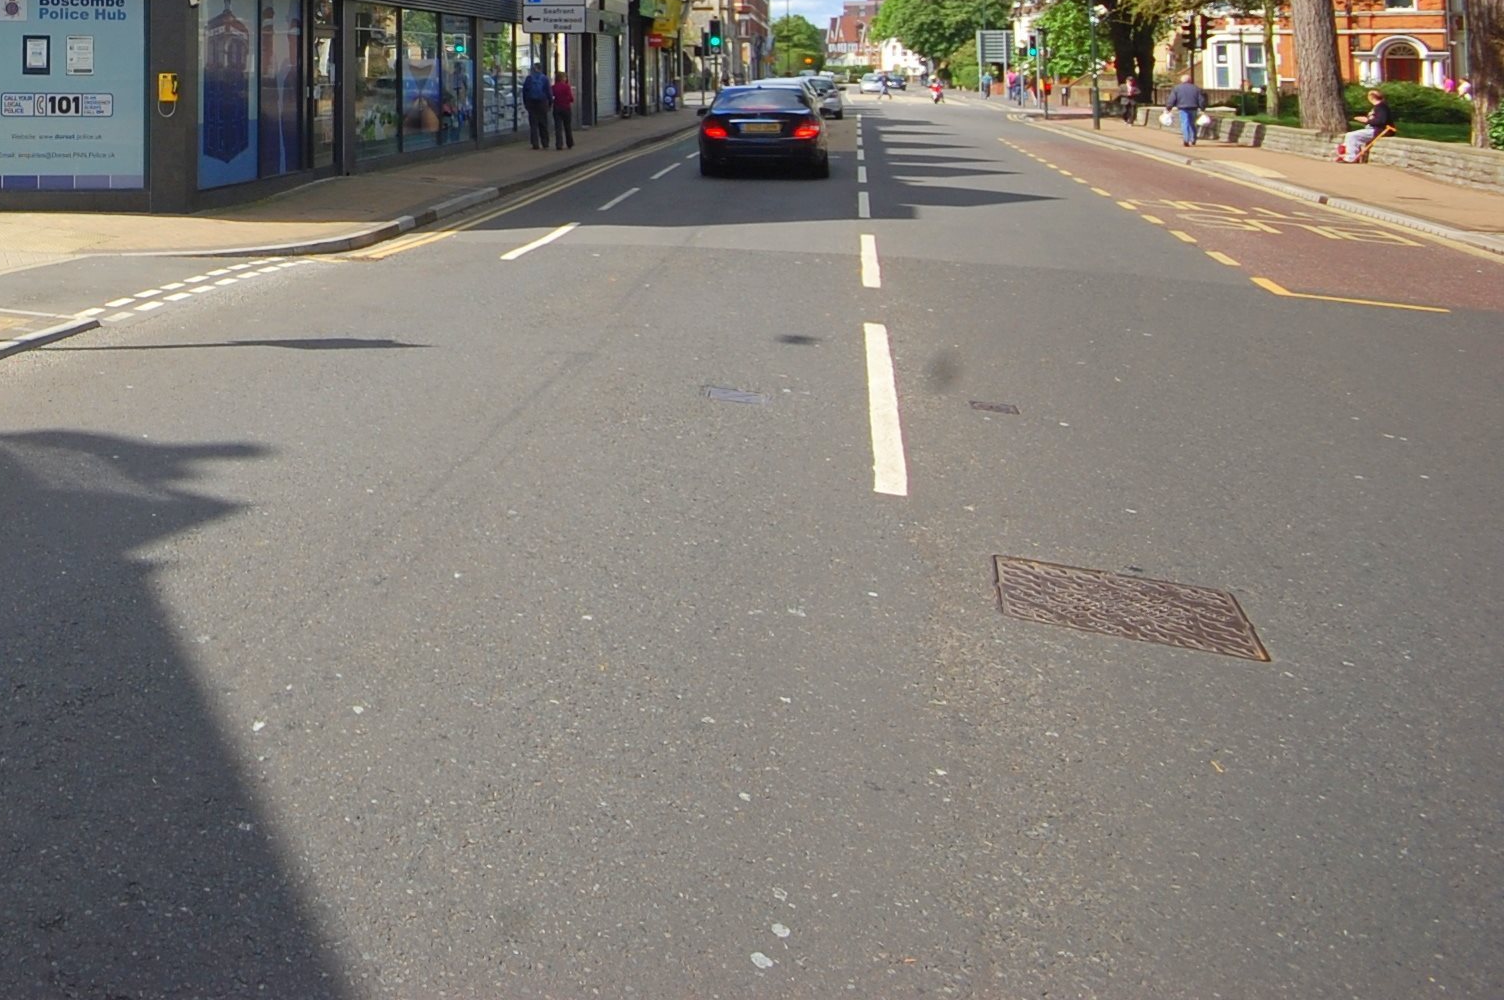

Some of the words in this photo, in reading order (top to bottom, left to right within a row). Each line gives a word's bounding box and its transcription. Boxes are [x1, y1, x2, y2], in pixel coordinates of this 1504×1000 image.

[39, 7, 89, 20] Police
[95, 8, 127, 20] Hub
[48, 96, 80, 114] 101
